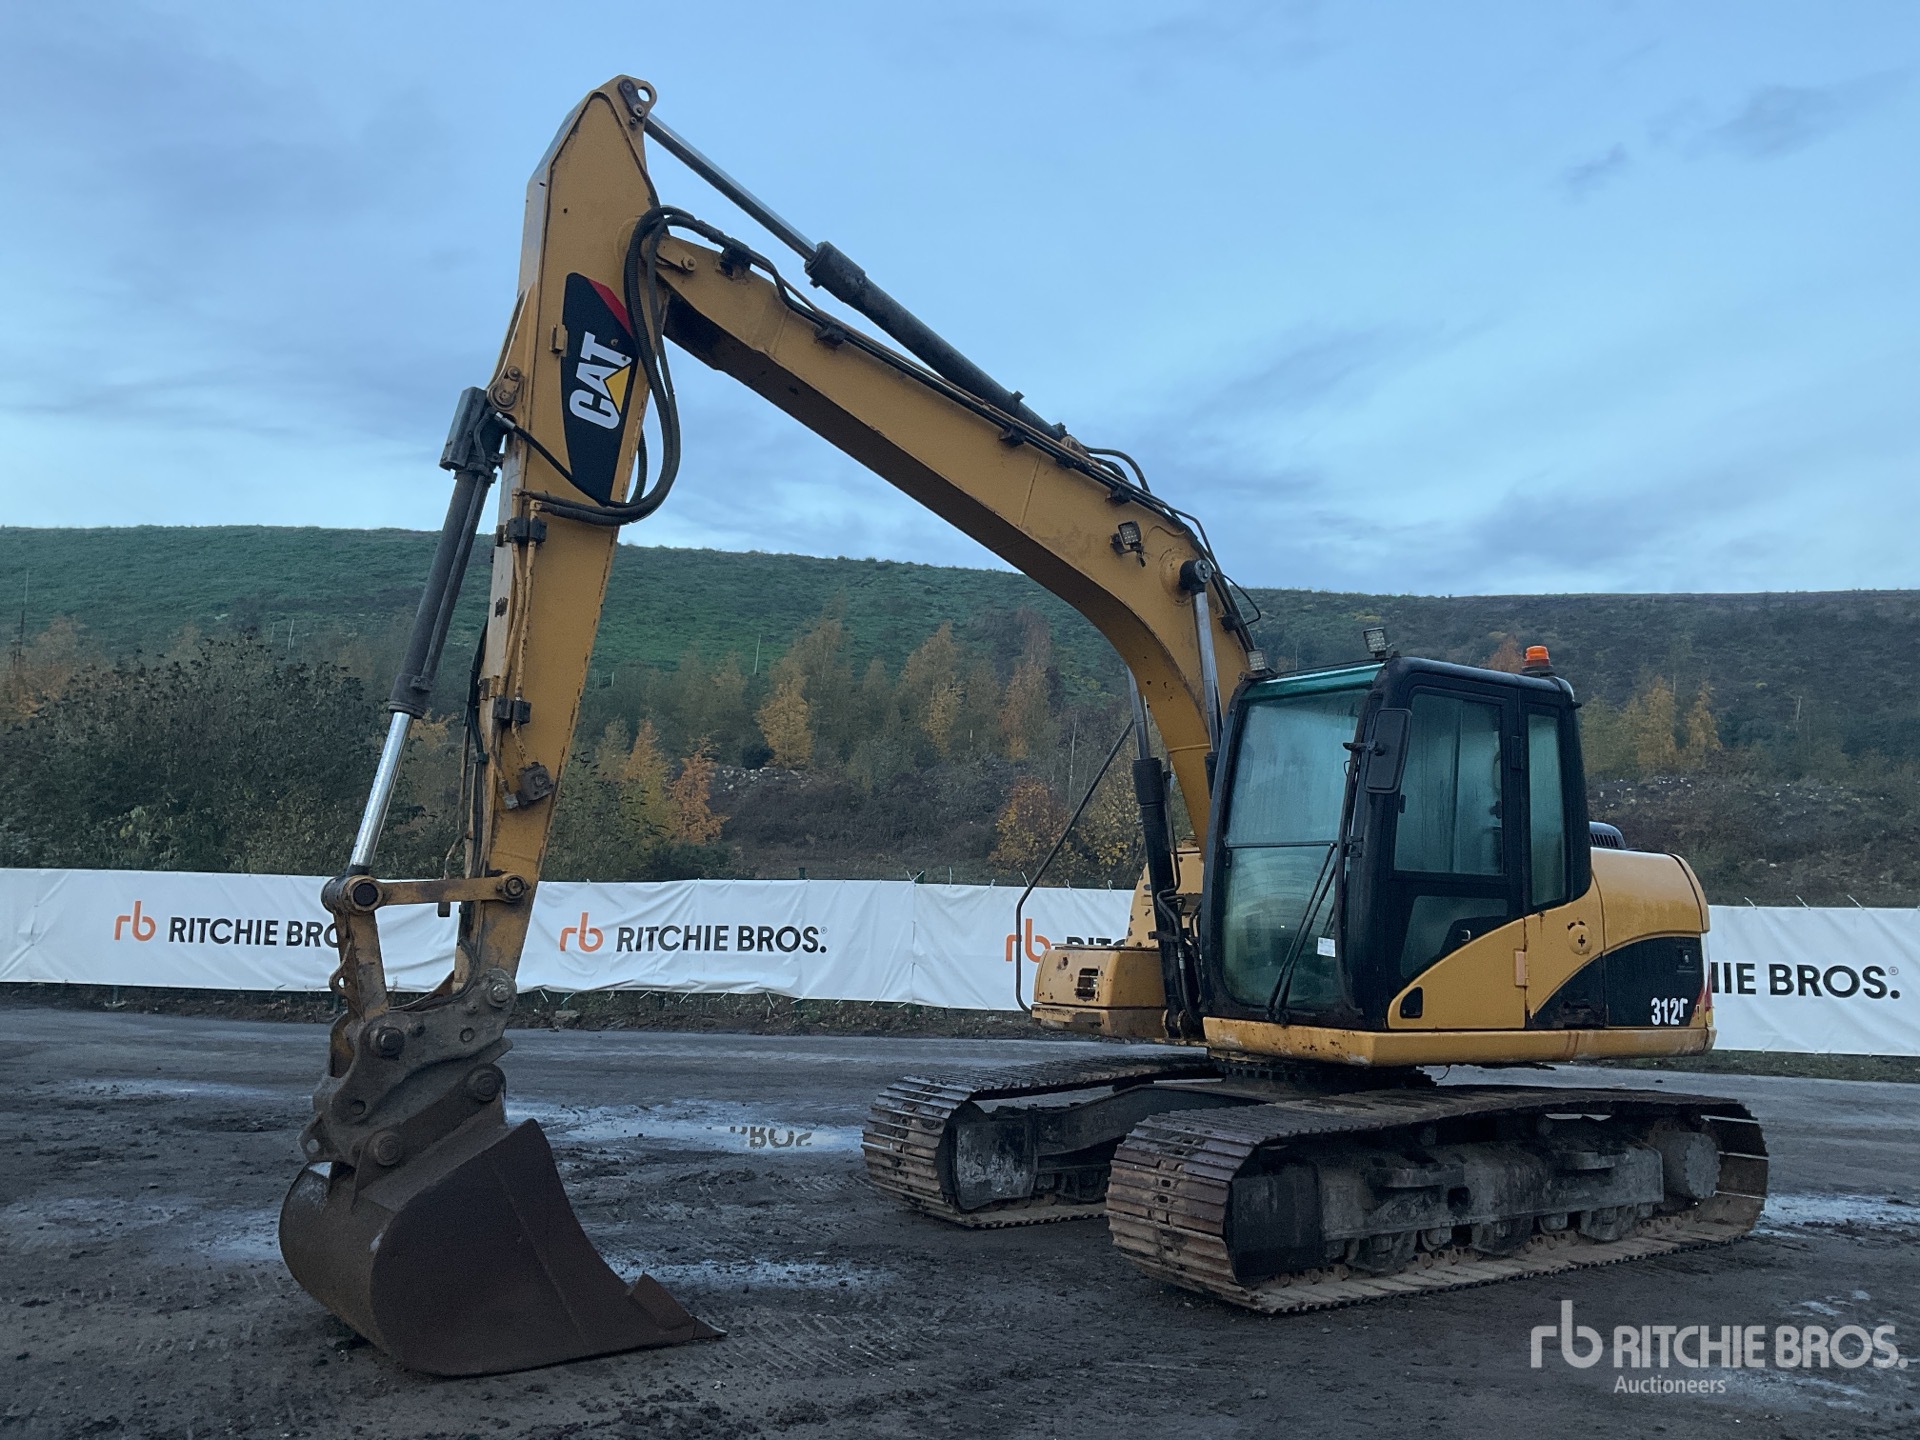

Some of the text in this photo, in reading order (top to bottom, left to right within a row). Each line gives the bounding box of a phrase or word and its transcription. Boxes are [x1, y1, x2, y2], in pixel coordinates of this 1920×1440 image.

[569, 331, 632, 429] CAT
[114, 901, 340, 948] rb RITCHIE BRO
[559, 912, 828, 953] rb RITCHIE BROS.
[1768, 963, 1901, 1000] BROS.
